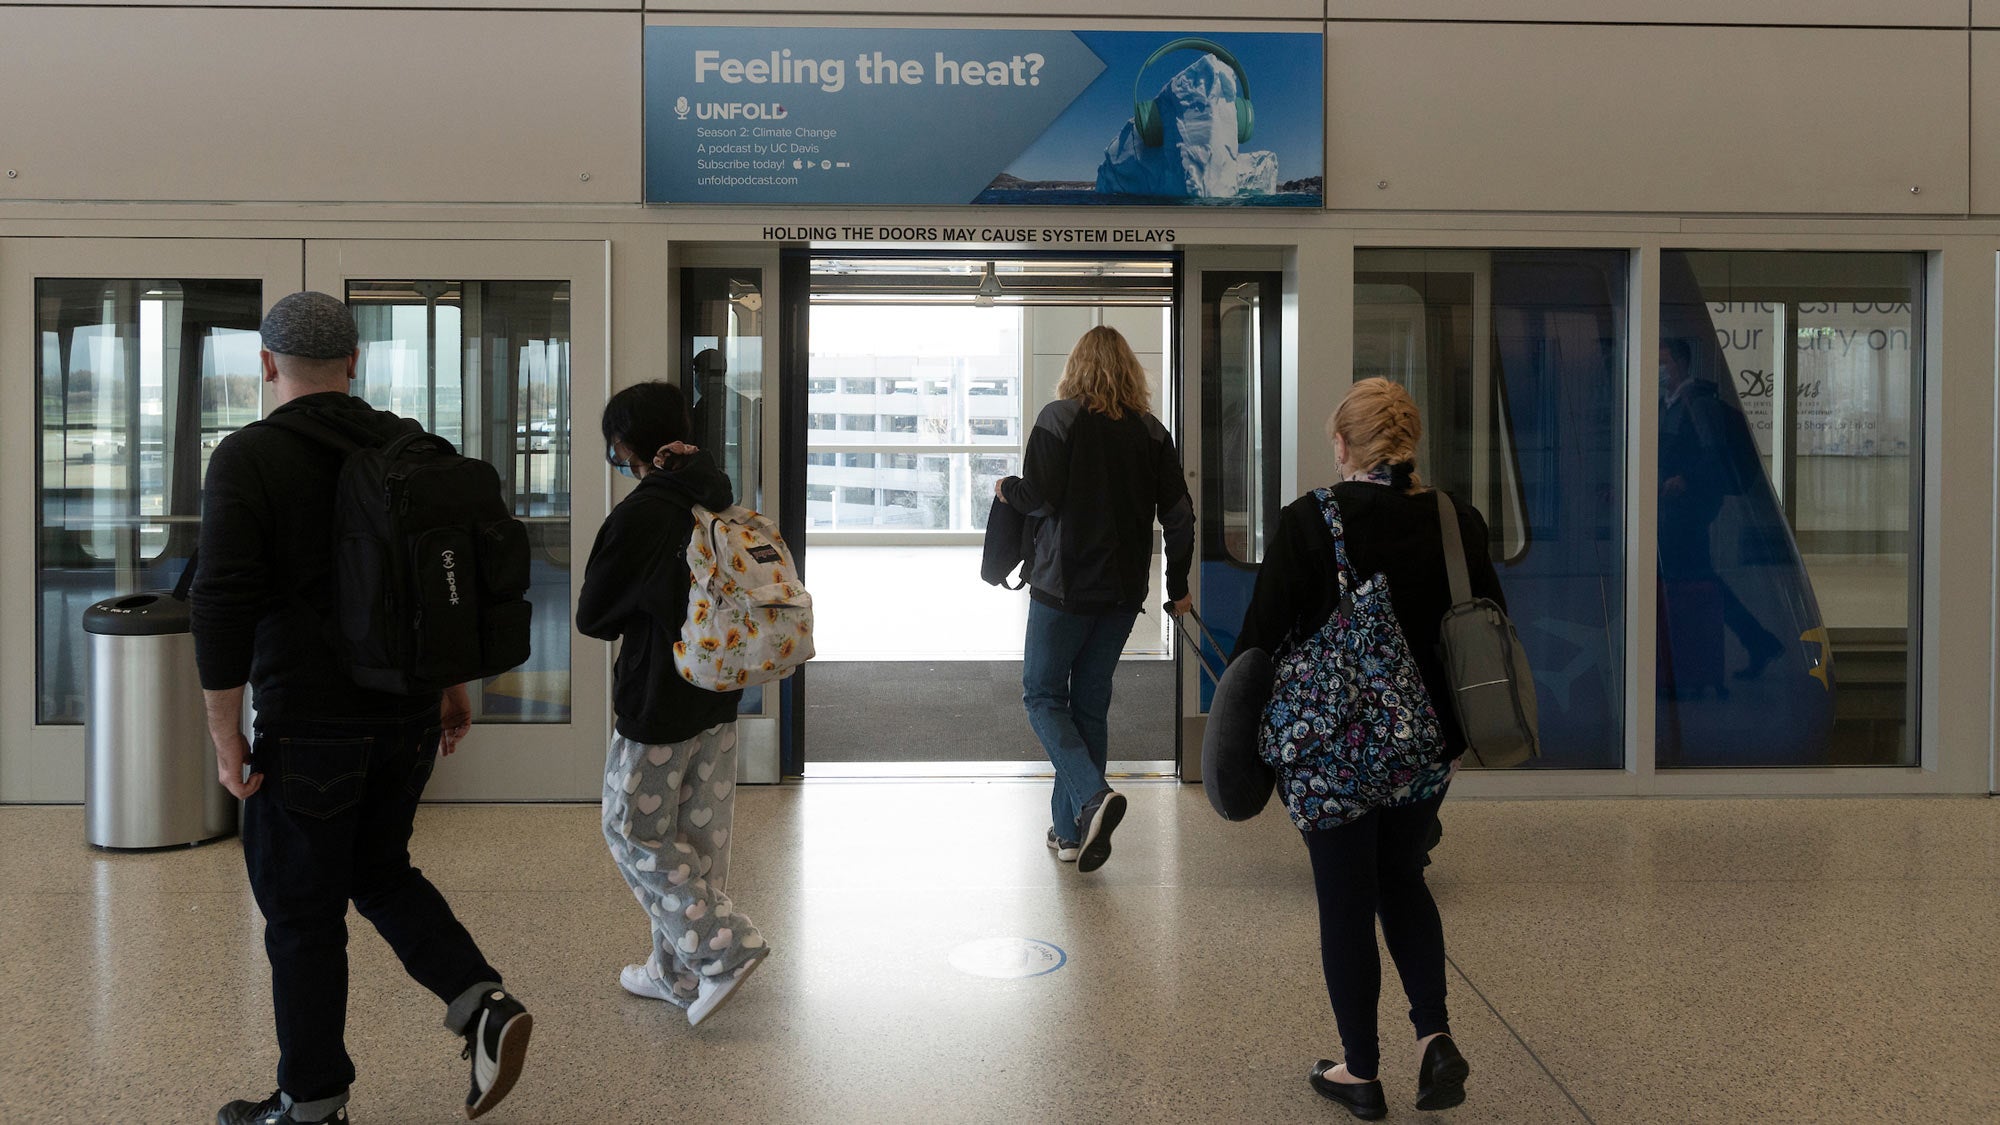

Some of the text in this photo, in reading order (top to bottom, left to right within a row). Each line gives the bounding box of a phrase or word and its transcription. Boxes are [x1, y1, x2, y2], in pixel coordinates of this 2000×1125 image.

[694, 49, 1045, 93] Feeling the heat?
[696, 103, 788, 120] UNFOLD
[697, 127, 837, 140] Season 2: Climate Change
[697, 143, 820, 156] A podcast by UC Davis
[697, 159, 785, 171] Subscribe today!
[697, 175, 798, 187] unfoldpodcast.com
[762, 226, 1176, 243] HOLDING THE DOORS MAY CAUSE SYSTEM DELAYS
[446, 571, 460, 605] speck
